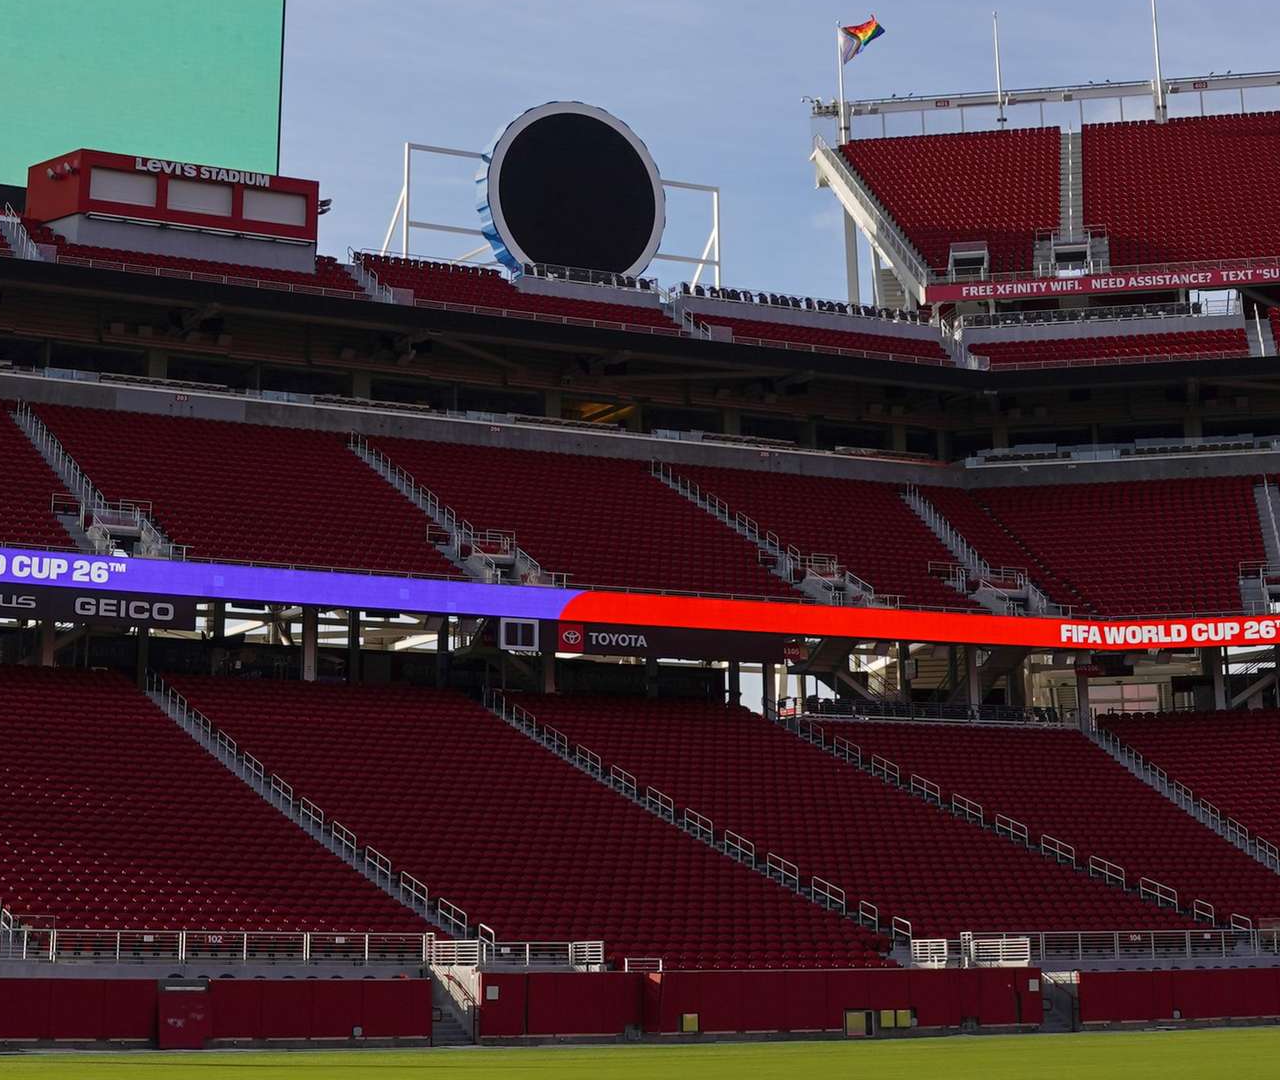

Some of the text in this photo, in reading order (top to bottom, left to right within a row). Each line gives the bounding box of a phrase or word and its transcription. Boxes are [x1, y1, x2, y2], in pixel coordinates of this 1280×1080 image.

[200, 165, 269, 187] STADIUM
[962, 285, 994, 297] FREE
[996, 281, 1047, 294] XFINITY
[1050, 280, 1082, 292] WIFI.
[1091, 277, 1124, 289] NEED
[1128, 272, 1212, 288] ASSISTANCE?
[1220, 269, 1253, 281] TEXT
[12, 554, 68, 580] CUP
[75, 597, 174, 621] GEICO
[589, 632, 648, 648] TOYOTA
[1061, 624, 1102, 644] FIFA
[1104, 623, 1188, 645] WORLD
[1191, 621, 1240, 641] CUP
[207, 934, 223, 943] 102
